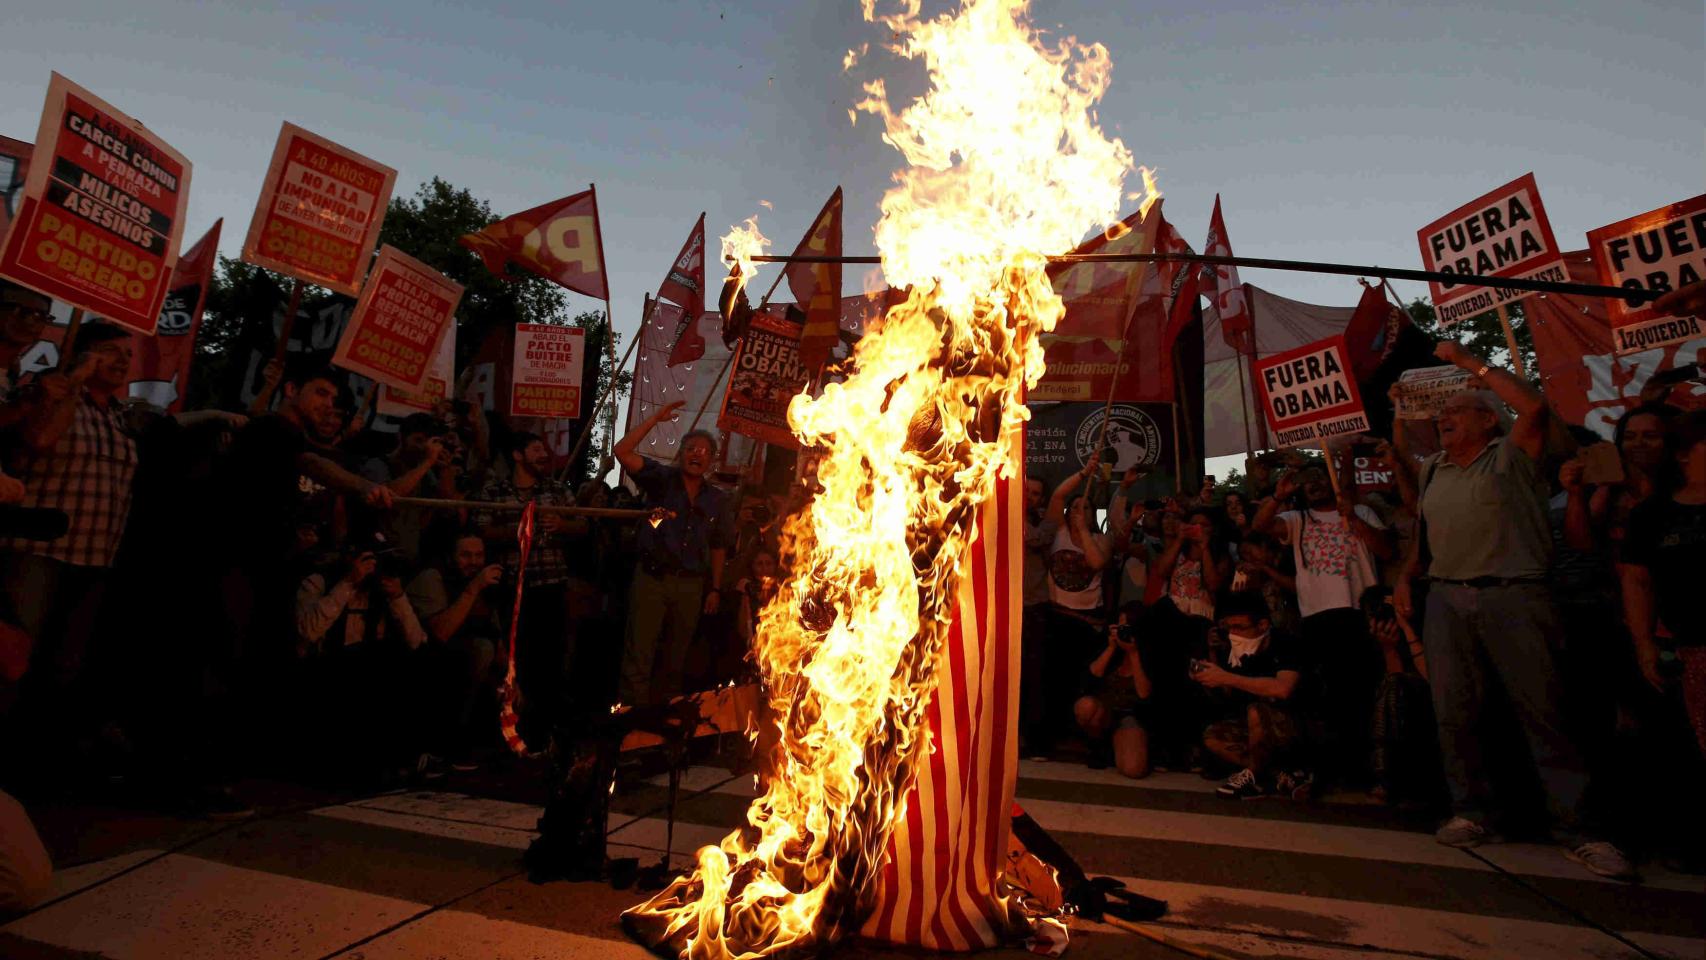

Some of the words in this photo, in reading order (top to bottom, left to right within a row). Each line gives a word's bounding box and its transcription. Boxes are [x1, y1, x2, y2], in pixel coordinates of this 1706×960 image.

[68, 114, 130, 162] CARCEL
[132, 153, 177, 191] COMUN
[82, 143, 94, 158] A
[99, 151, 161, 198] PEDRAZA
[296, 147, 306, 160] A
[311, 154, 328, 170] 40
[79, 172, 153, 225] MILICOS
[283, 182, 366, 224] IMPUNIDAD
[301, 172, 322, 189] NO
[326, 182, 336, 196] A
[341, 187, 359, 205] LA
[62, 191, 153, 248] ASESINOS
[270, 218, 357, 260] PARTIDO
[1431, 196, 1532, 262] FUERA
[38, 212, 157, 280] PARTIDO
[1440, 229, 1543, 290] OBAMA
[36, 240, 146, 299] OBRERO
[1622, 258, 1706, 308] OBA
[373, 313, 390, 330] DE
[378, 282, 445, 324] PROTOCOLO
[1438, 291, 1494, 323] IZQUIERDA
[359, 328, 426, 366] PARTIDO
[527, 341, 571, 352] PACTO
[533, 333, 558, 342] ABAJO
[1619, 317, 1701, 350] IZQUIERDA
[526, 350, 573, 362] BUITRE
[740, 353, 812, 381] OBAMA
[1264, 350, 1341, 393] FUERA
[516, 386, 577, 399] PARTIDO
[1273, 380, 1350, 418] OBAMA
[1042, 441, 1067, 450] ENA
